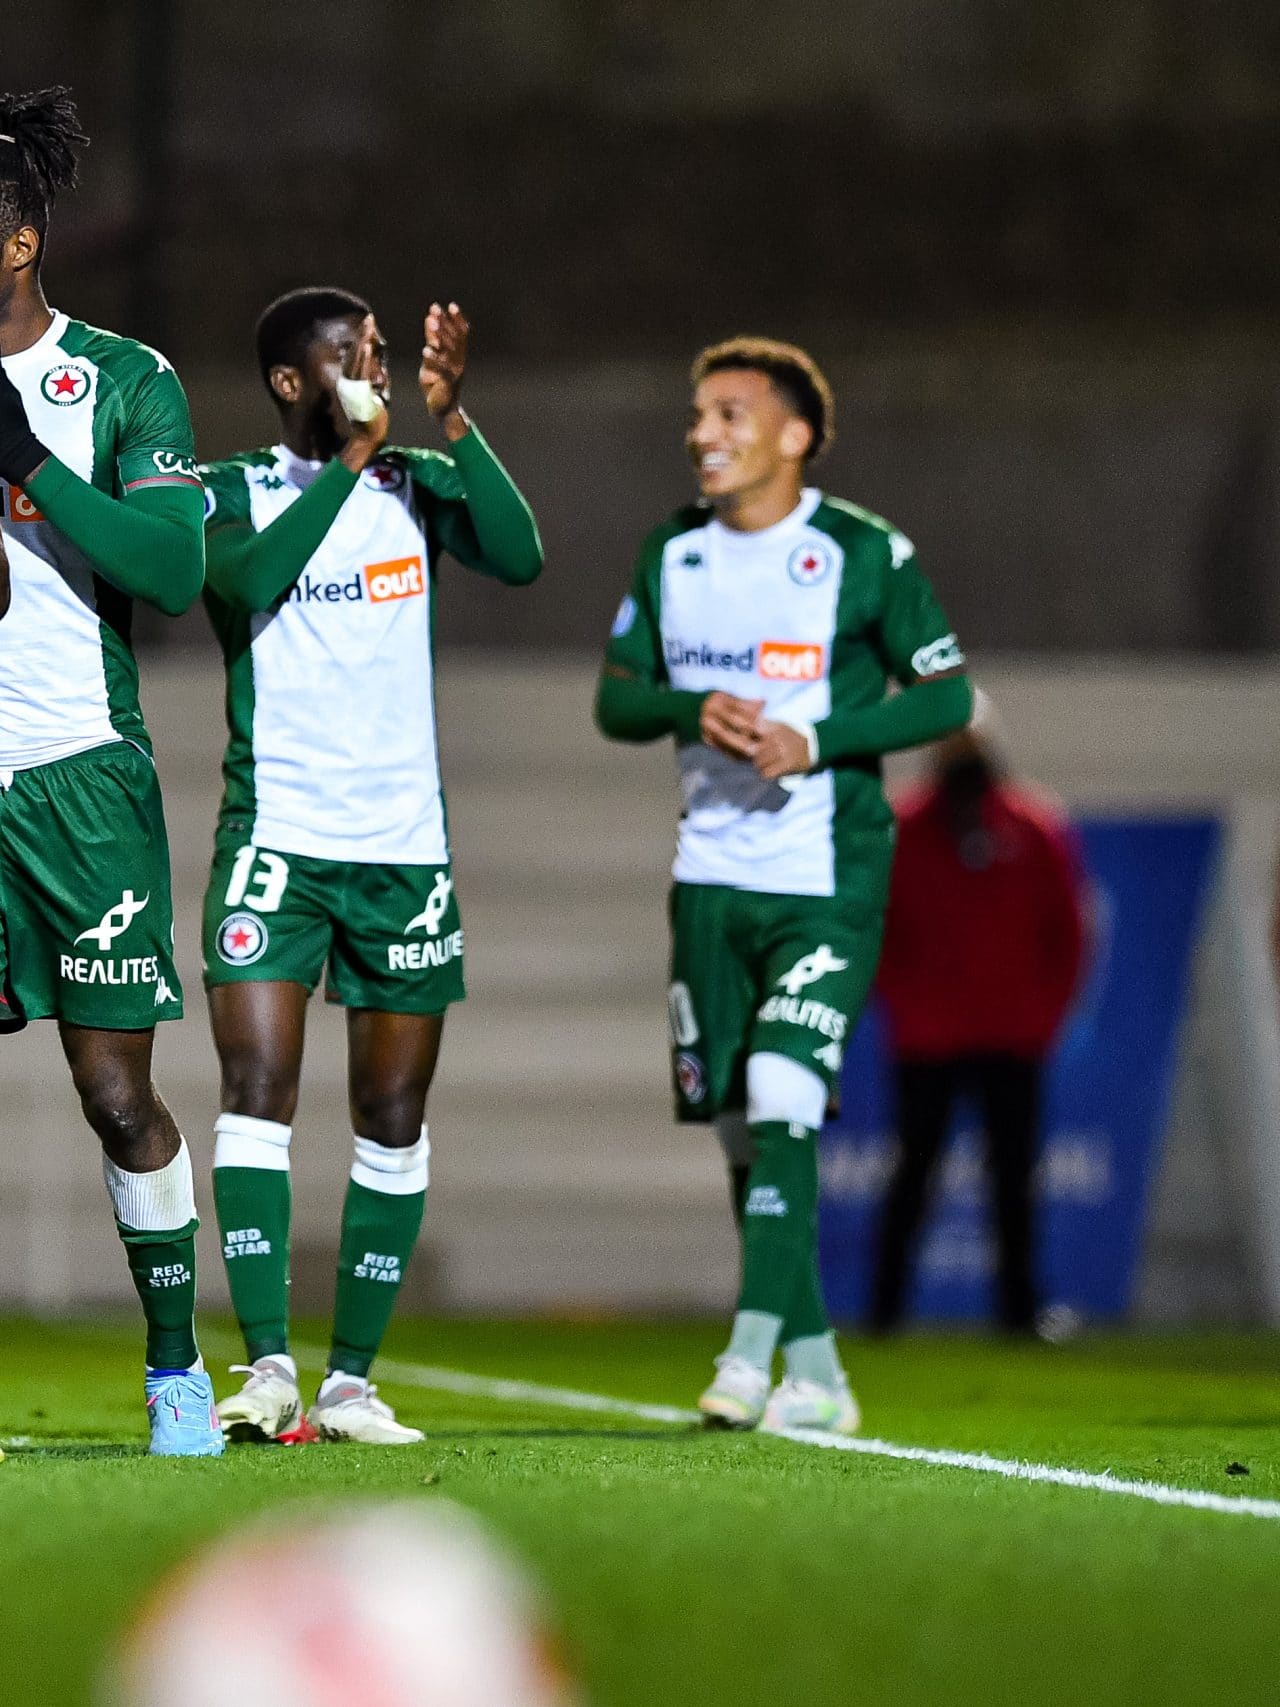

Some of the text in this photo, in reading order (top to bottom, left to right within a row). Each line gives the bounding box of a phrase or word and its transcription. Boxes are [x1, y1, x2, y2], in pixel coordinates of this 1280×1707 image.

[288, 564, 419, 602] nked out
[224, 845, 289, 912] 13
[60, 954, 158, 985] REALITES
[226, 1228, 262, 1245] RED
[224, 1240, 271, 1259] STAR
[363, 1252, 400, 1269] RED
[149, 1270, 191, 1287] STAR
[152, 1264, 184, 1278] RED
[354, 1264, 401, 1283] STAR
